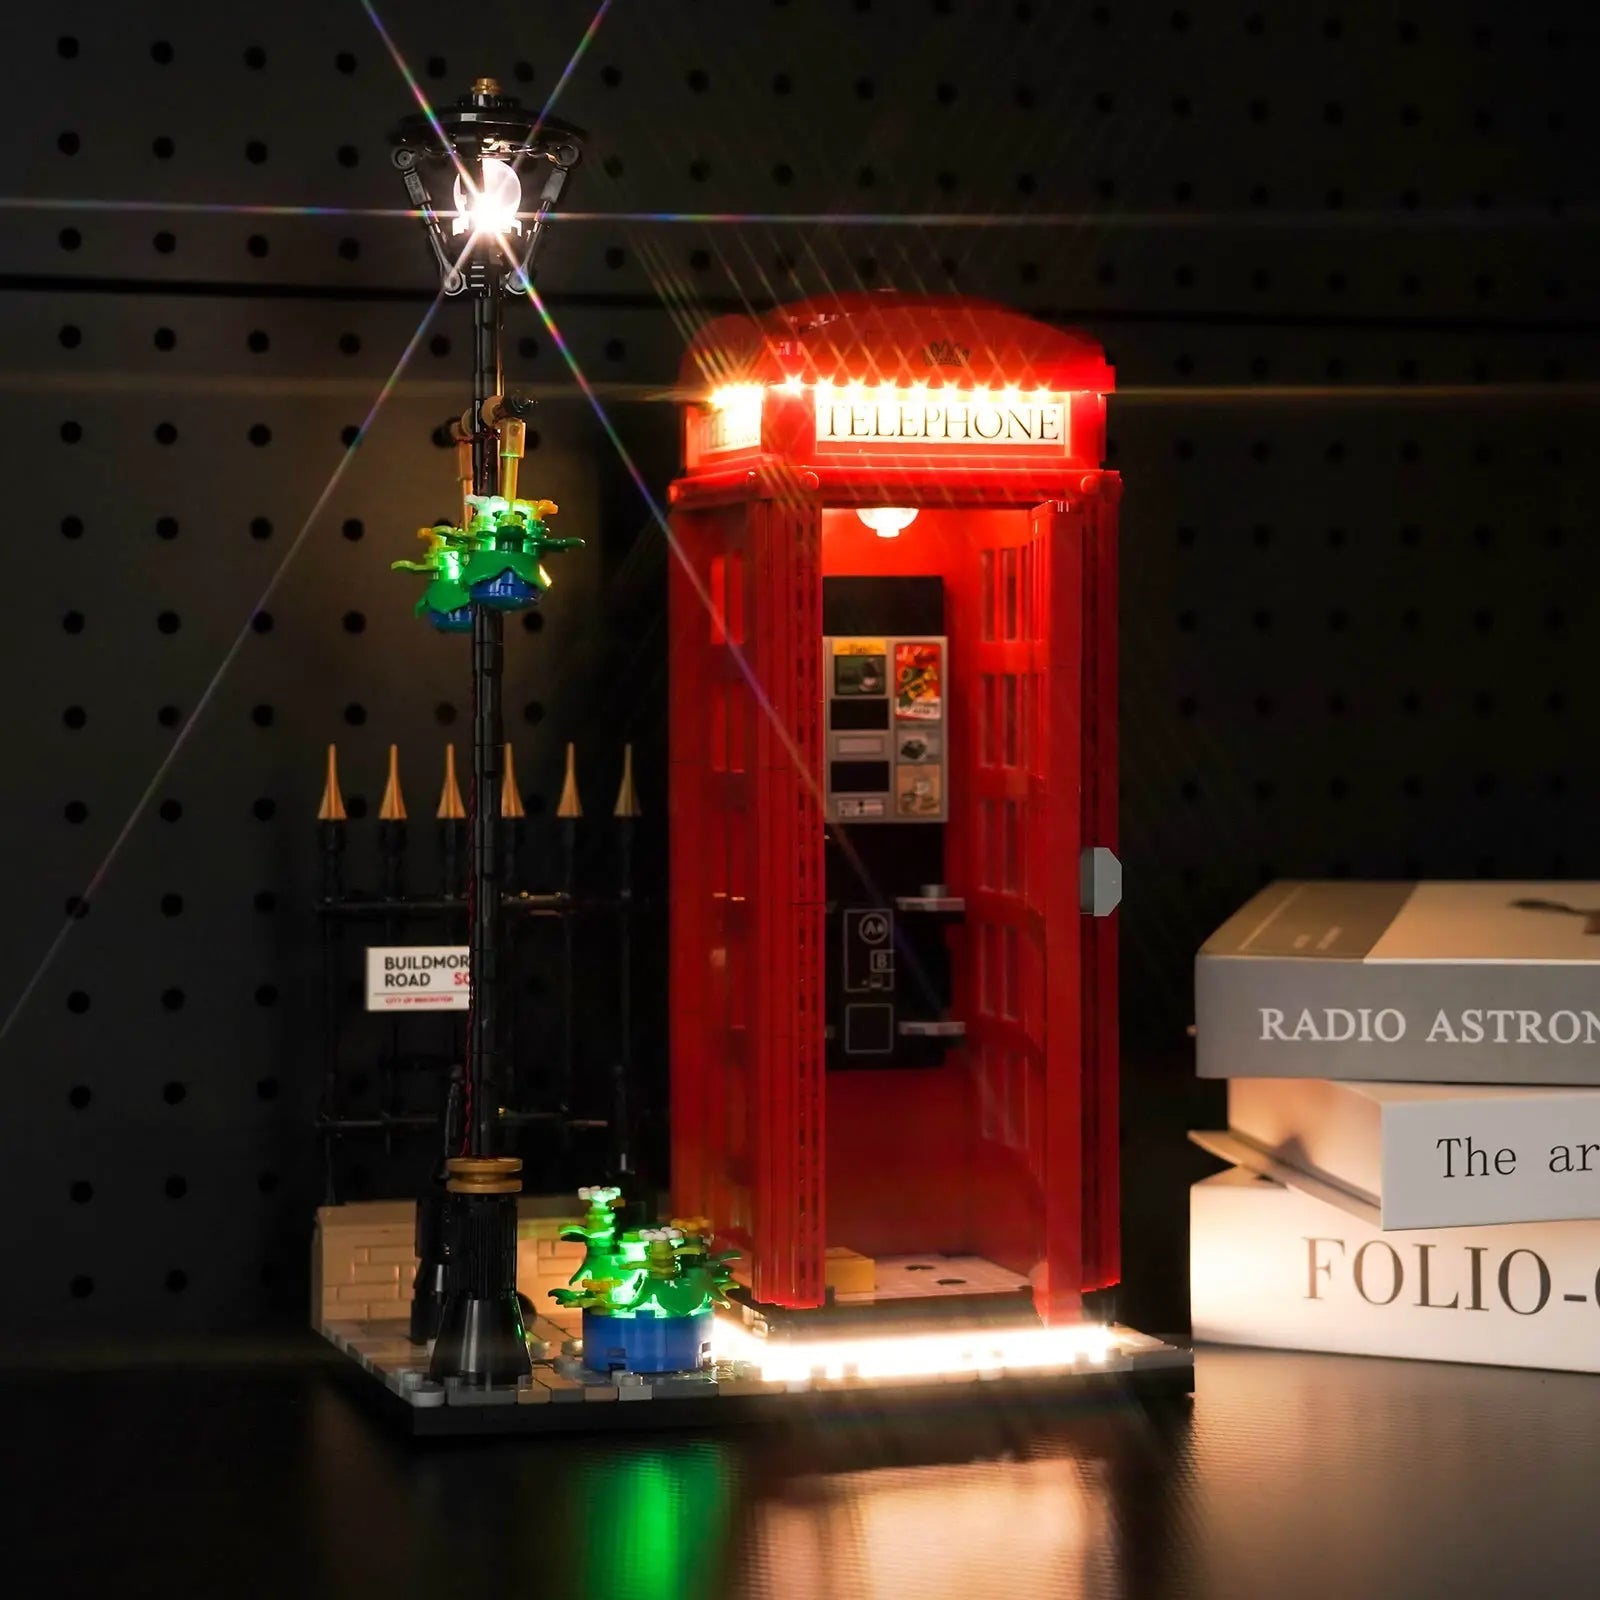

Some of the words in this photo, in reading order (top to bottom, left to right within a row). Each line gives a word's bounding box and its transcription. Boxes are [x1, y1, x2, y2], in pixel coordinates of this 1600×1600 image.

[822, 405, 1060, 440] TELEPHONE
[384, 972, 431, 988] ROAD
[1258, 1007, 1407, 1042] RADIO
[1436, 1136, 1517, 1178] The
[1548, 1143, 1600, 1174] ar
[1302, 1236, 1600, 1316] FOLIO-
